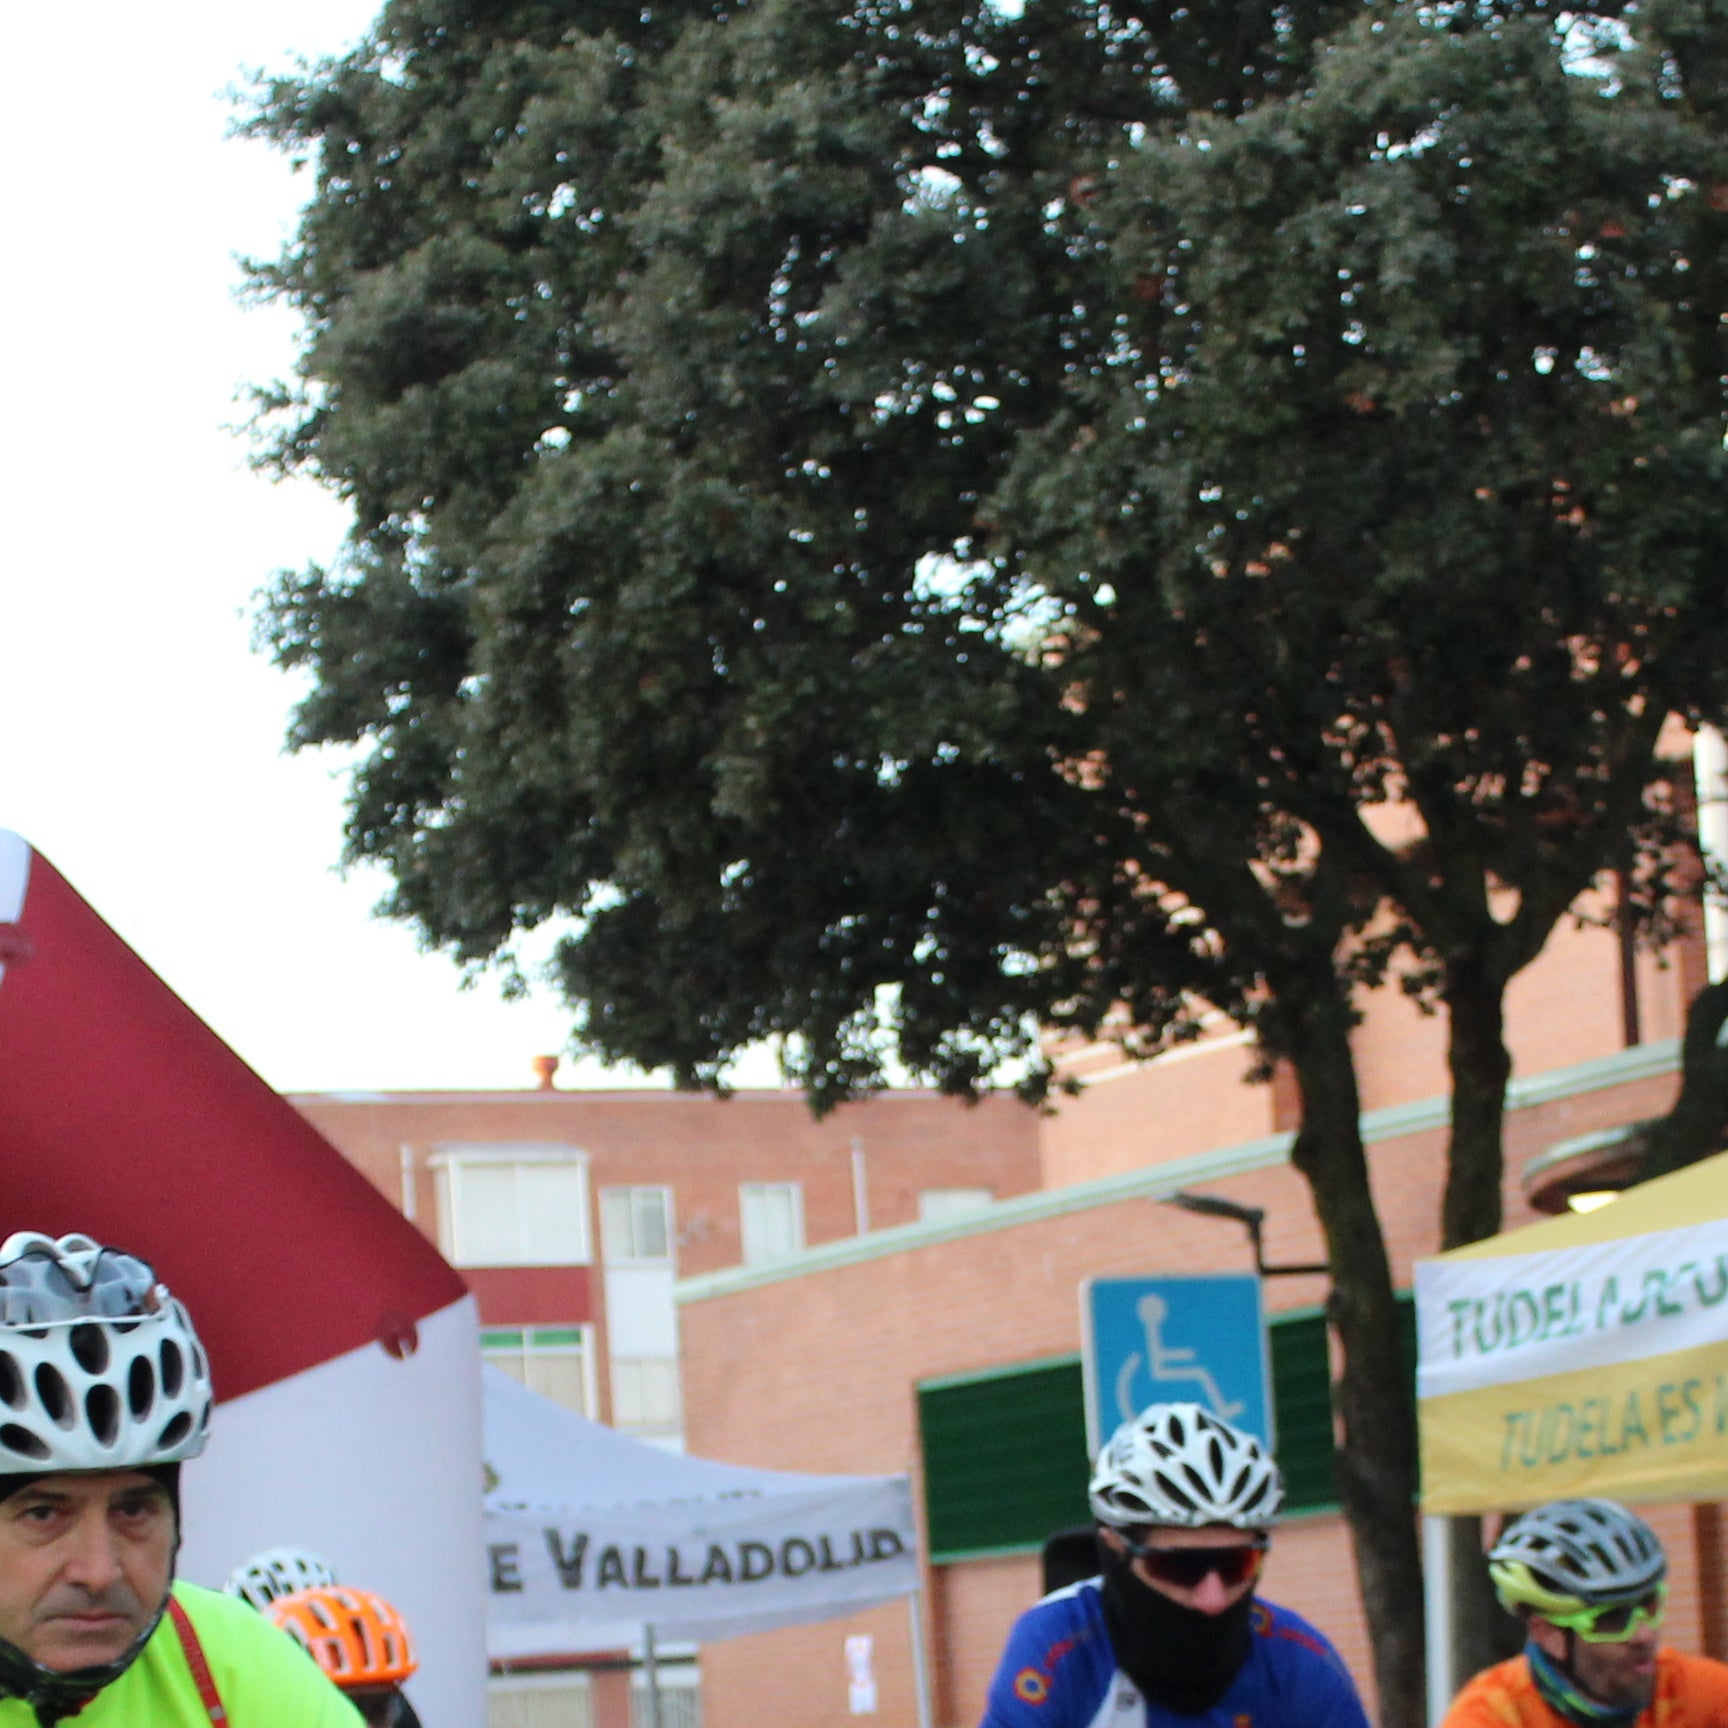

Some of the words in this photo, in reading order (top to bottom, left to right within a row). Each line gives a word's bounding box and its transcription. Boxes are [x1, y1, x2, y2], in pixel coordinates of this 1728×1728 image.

[1498, 1392, 1650, 1470] TUDELA
[1656, 1379, 1702, 1445] ES
[490, 1543, 524, 1592] E
